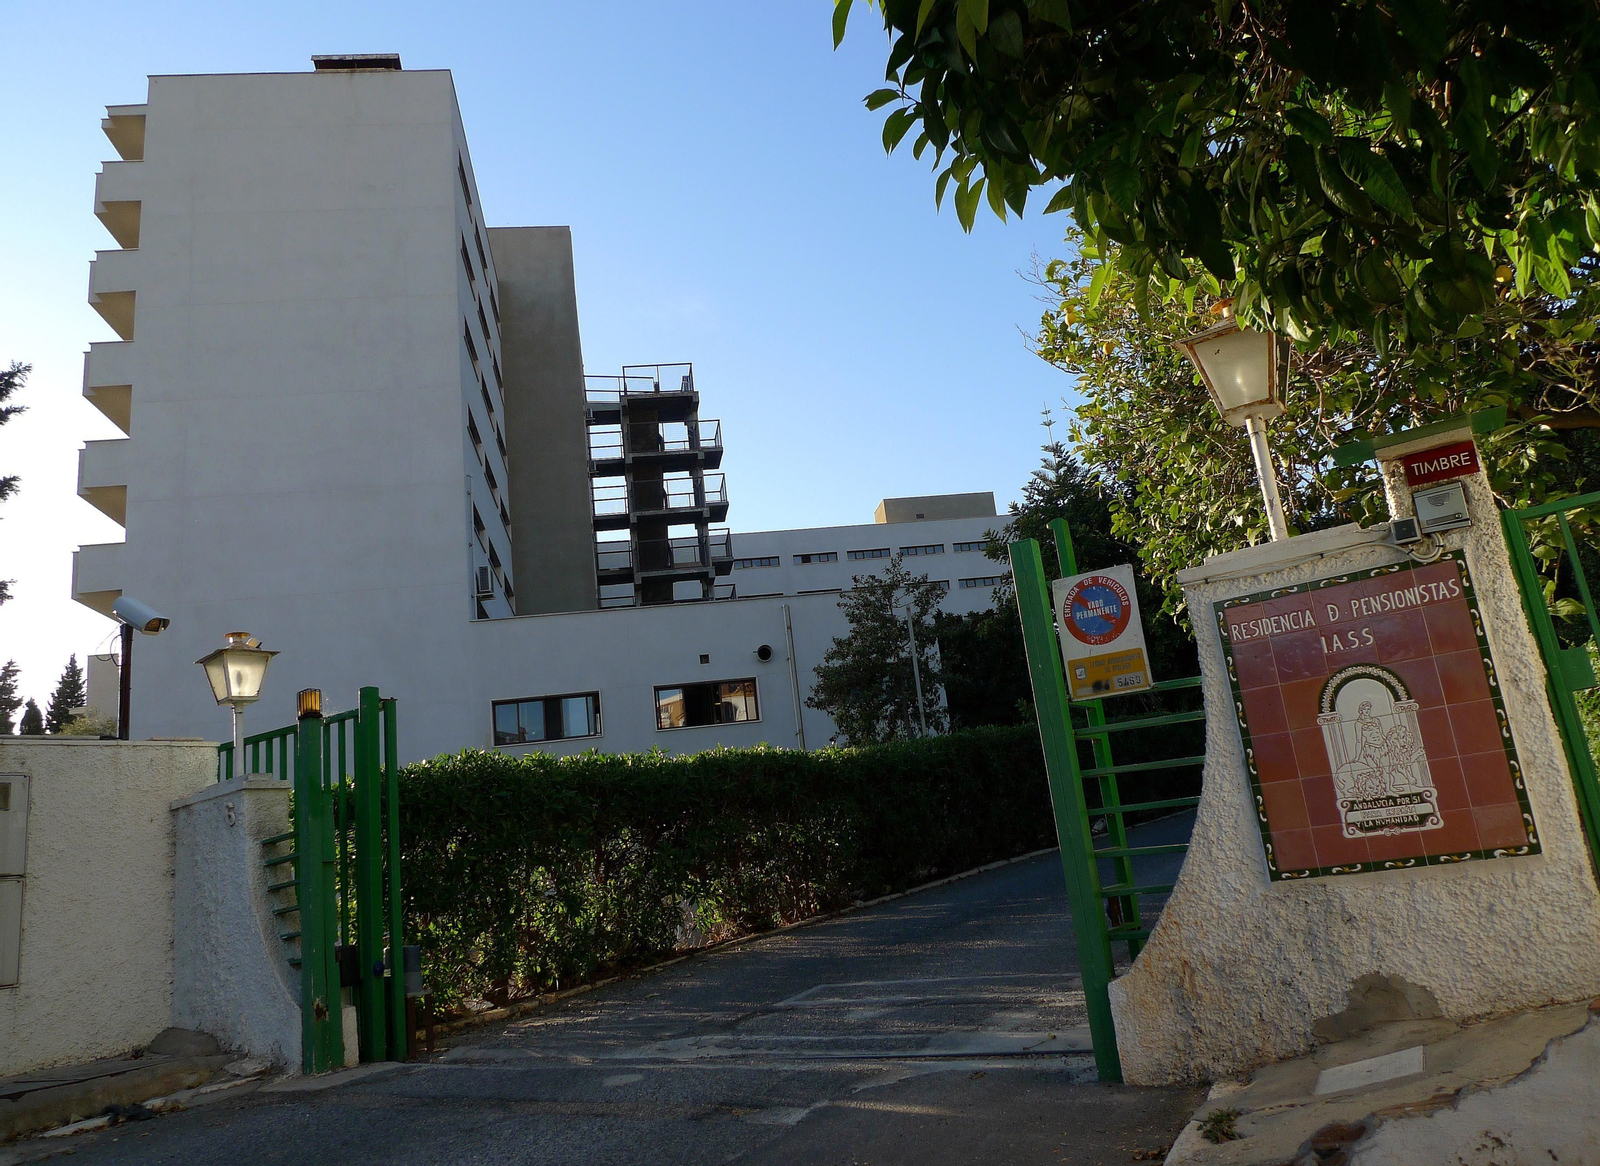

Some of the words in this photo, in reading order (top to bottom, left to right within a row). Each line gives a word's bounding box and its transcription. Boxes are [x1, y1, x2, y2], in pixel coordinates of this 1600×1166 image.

[1411, 452, 1471, 476] TIMBRE
[1064, 586, 1080, 618] ENTRADA
[1083, 577, 1093, 586] DE
[1098, 576, 1130, 606] VEHICULOS
[1087, 599, 1104, 610] VADO
[1231, 609, 1317, 641] RESIDENCIA
[1351, 578, 1461, 618] PENSIONISTAS
[1076, 604, 1118, 620] PERMANENTE
[1117, 675, 1141, 687] 5469
[1396, 796, 1411, 805] POR
[1412, 795, 1421, 804] SI
[1364, 819, 1374, 827] LA
